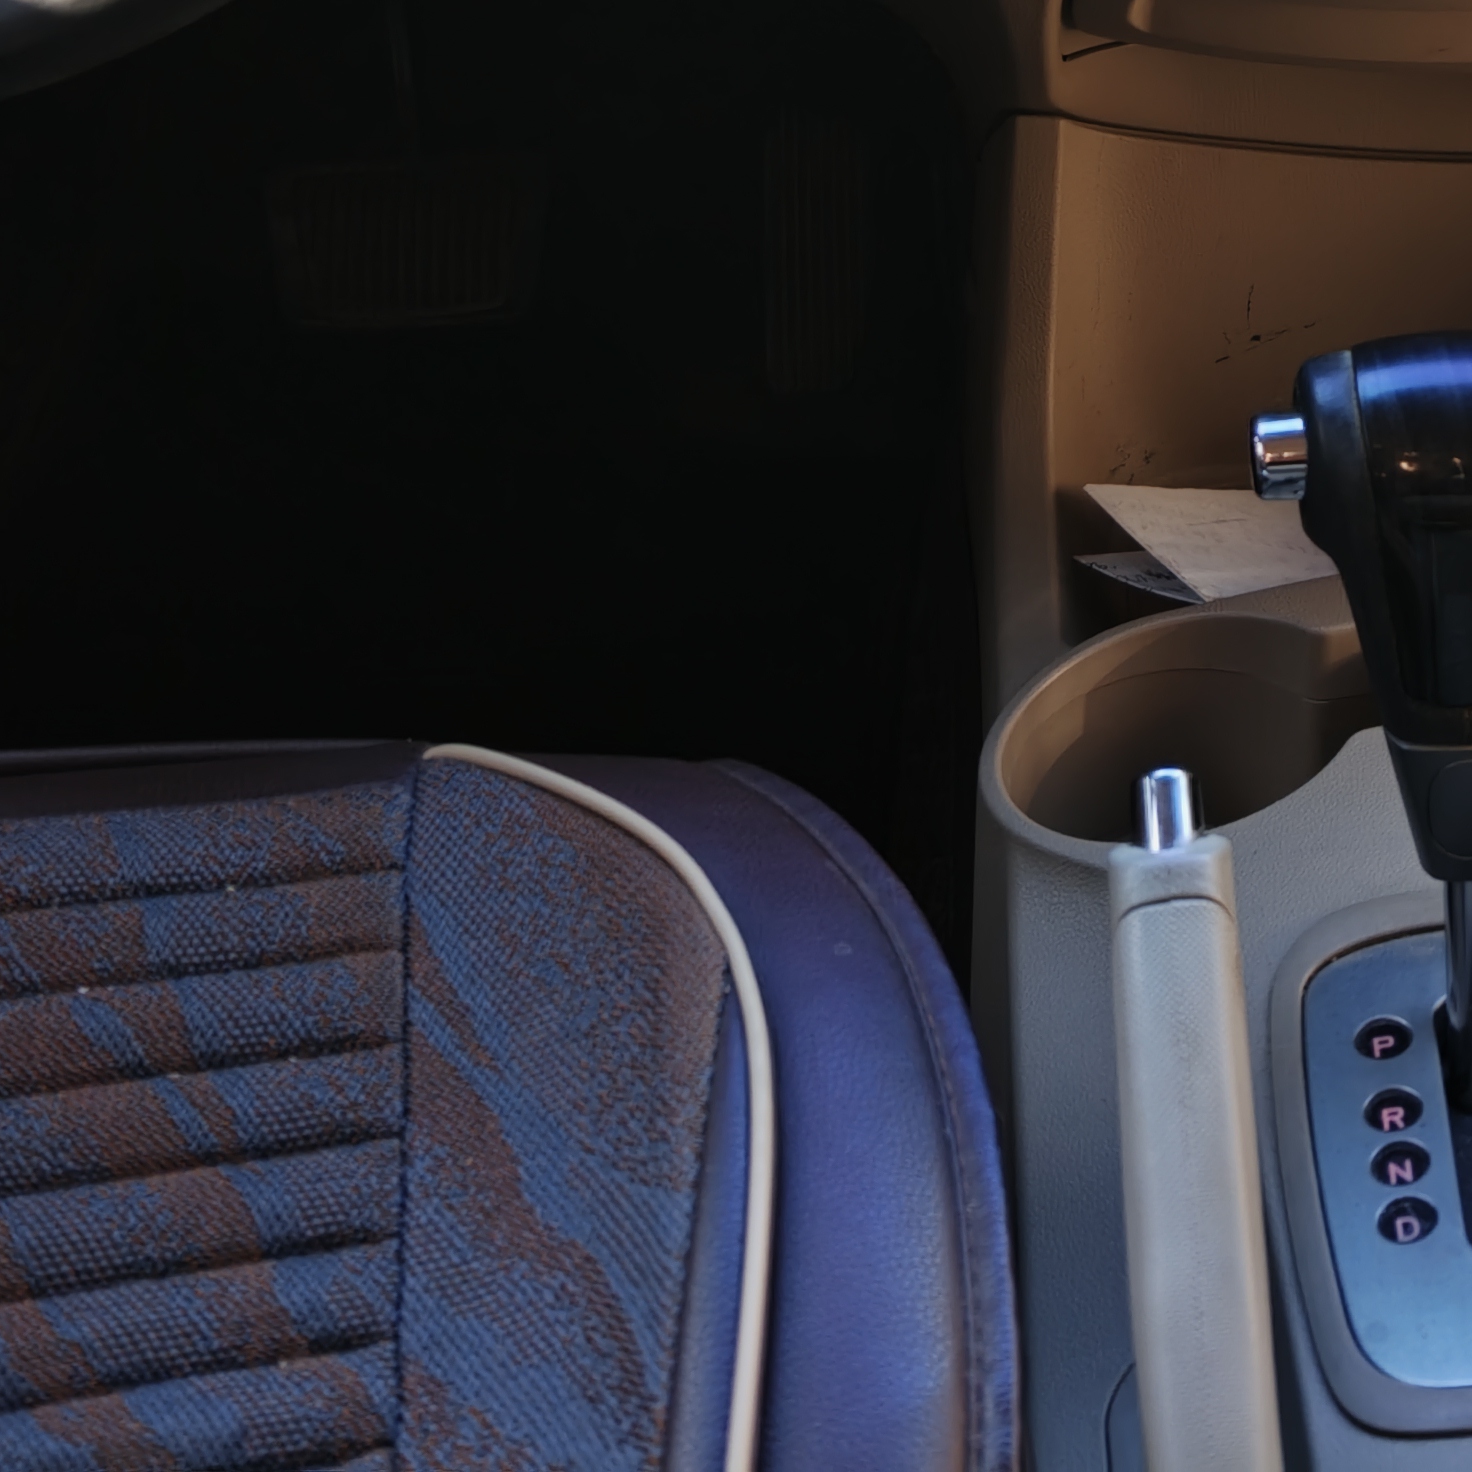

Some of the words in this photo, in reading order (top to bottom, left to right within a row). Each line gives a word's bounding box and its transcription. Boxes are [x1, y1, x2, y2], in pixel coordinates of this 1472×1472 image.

[1371, 1035, 1395, 1059] P
[1380, 1106, 1405, 1132] R
[1387, 1158, 1415, 1185] N
[1395, 1216, 1420, 1243] D
